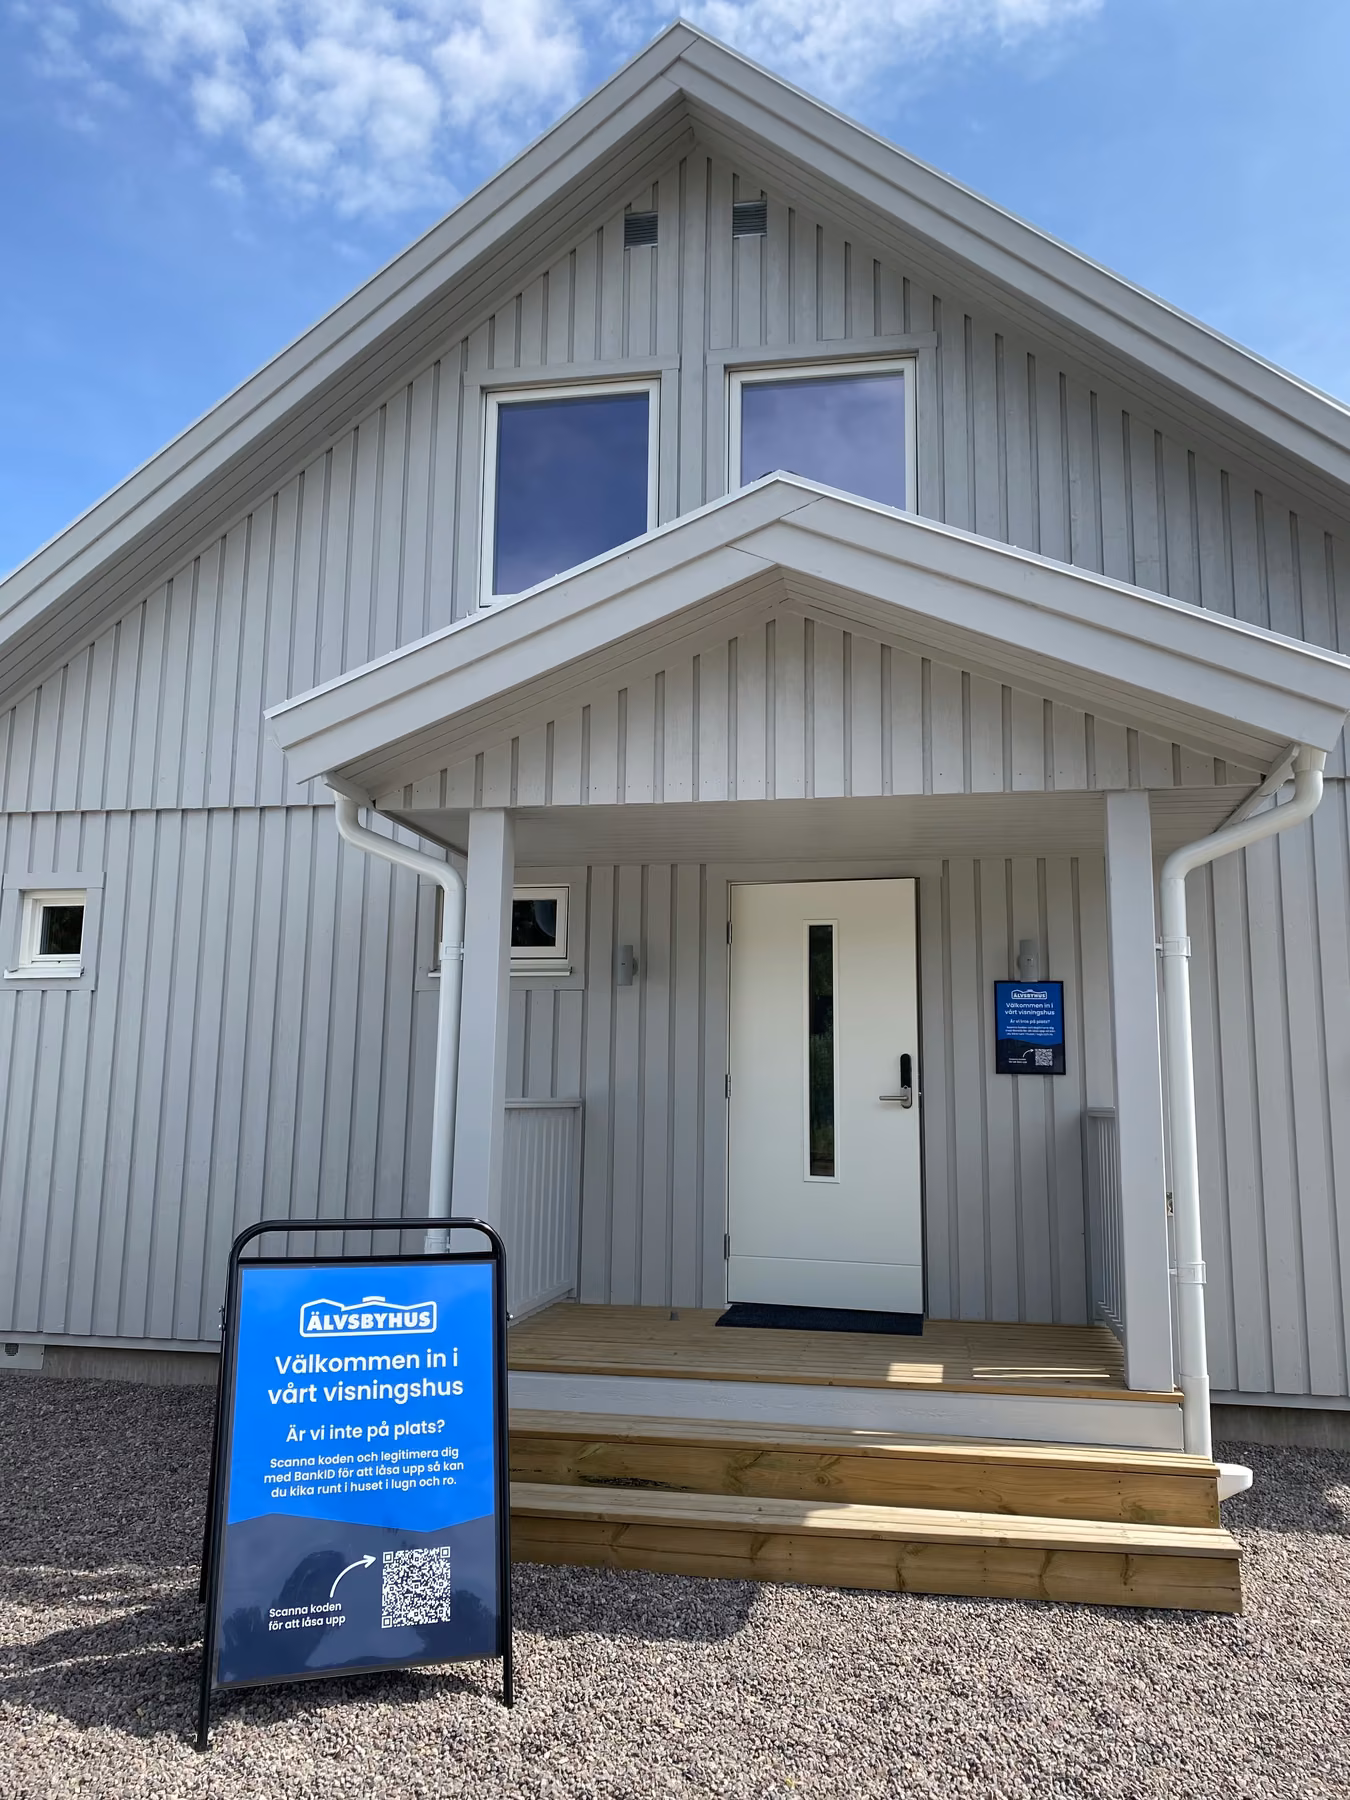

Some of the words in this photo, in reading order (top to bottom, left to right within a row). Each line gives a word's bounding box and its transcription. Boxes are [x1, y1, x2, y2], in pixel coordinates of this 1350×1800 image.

[306, 1312, 430, 1330] ÄLVSBYHUS
[275, 1353, 419, 1374] Välkommen
[426, 1347, 446, 1368] in
[453, 1347, 458, 1366] i
[267, 1381, 317, 1404] vårt
[323, 1377, 463, 1404] visningshus
[285, 1424, 306, 1442] Är
[309, 1424, 324, 1440] vi
[329, 1424, 362, 1439] inte
[367, 1420, 389, 1442] på
[393, 1419, 445, 1440] plats?
[270, 1457, 315, 1468] Scanna
[317, 1453, 354, 1464] koden
[356, 1451, 378, 1462] och
[380, 1449, 438, 1463] legitimera
[440, 1446, 458, 1459] dig
[263, 1471, 291, 1483] med
[293, 1469, 335, 1481] BankID
[337, 1467, 354, 1478] för
[356, 1466, 373, 1476] att
[375, 1464, 399, 1475] låsa
[402, 1464, 424, 1476] upp
[427, 1460, 440, 1472] så
[443, 1461, 464, 1470] kan
[270, 1486, 286, 1497] du
[289, 1484, 314, 1496] kika
[317, 1483, 341, 1494] runt
[344, 1481, 348, 1492] i
[350, 1480, 382, 1492] huset
[385, 1478, 389, 1489] i
[391, 1478, 416, 1491] lugn
[418, 1475, 440, 1486] och
[442, 1476, 456, 1484] ro.
[269, 1606, 308, 1617] Scanna
[310, 1602, 341, 1613] koden
[268, 1620, 283, 1630] för
[284, 1618, 300, 1629] att
[301, 1616, 323, 1627] låsa
[325, 1615, 345, 1626] upp
